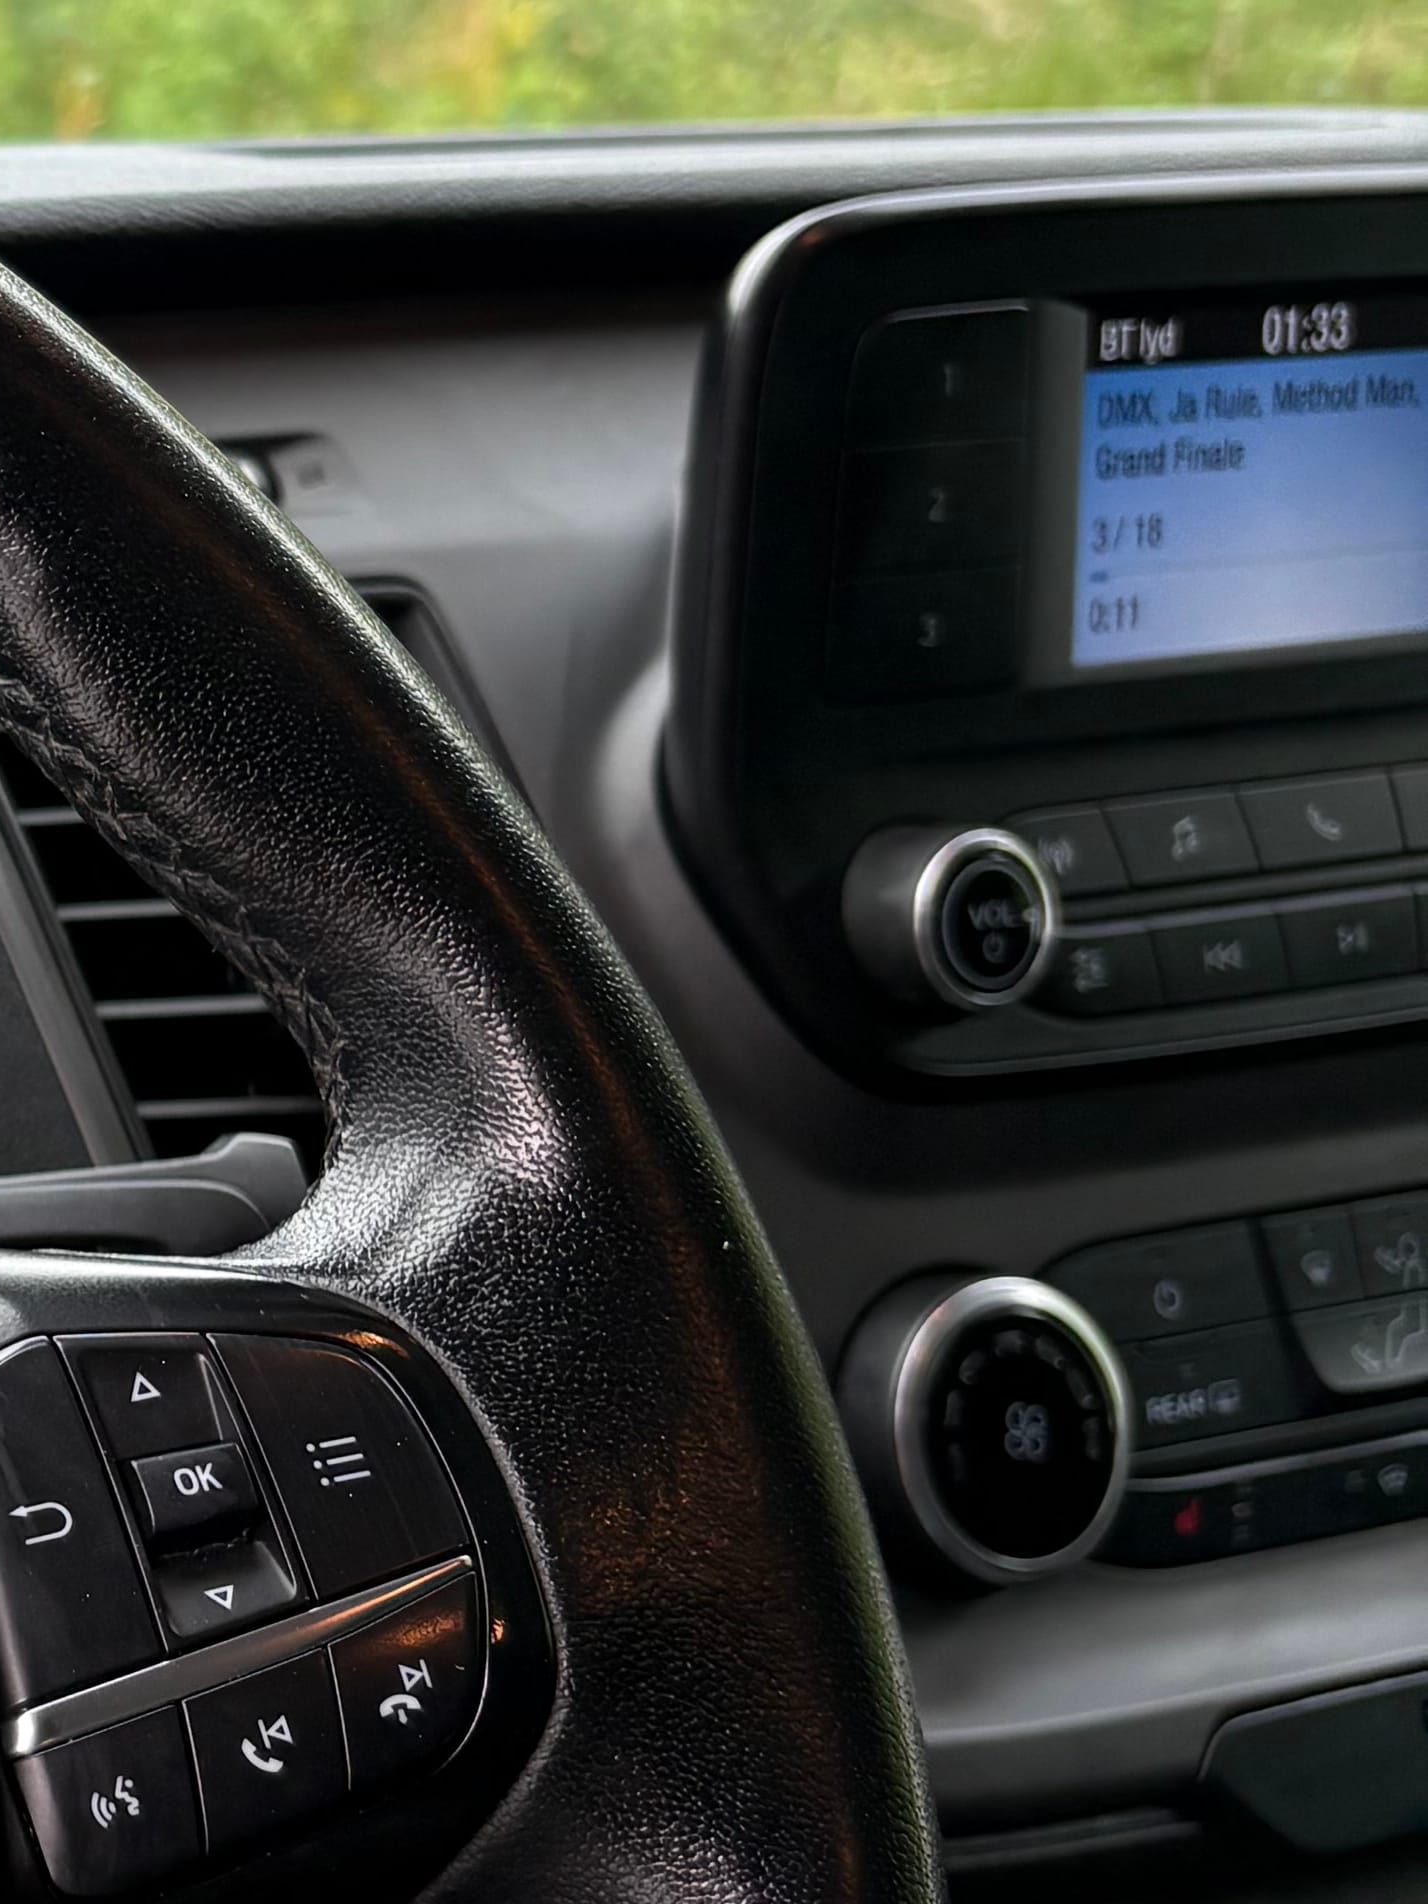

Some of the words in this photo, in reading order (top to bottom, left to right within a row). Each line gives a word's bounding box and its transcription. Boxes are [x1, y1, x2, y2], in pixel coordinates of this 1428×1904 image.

[1099, 319, 1137, 361] BT
[1140, 315, 1180, 363] lyd
[1262, 301, 1355, 355] 01:33
[1097, 391, 1160, 430] DMX,
[1168, 390, 1199, 424] Ja
[1205, 383, 1263, 422] Rule,
[1271, 378, 1359, 416] Method
[1095, 441, 1166, 480] Grand
[1172, 436, 1246, 472] Finale
[927, 487, 947, 523] 2
[1092, 516, 1107, 553] 3
[1134, 513, 1164, 547] 18
[916, 611, 940, 648] 3
[1089, 595, 1140, 634] 0:11
[967, 899, 1018, 931] VOL
[1146, 1386, 1207, 1426] REAR
[173, 1463, 223, 1496] OK
